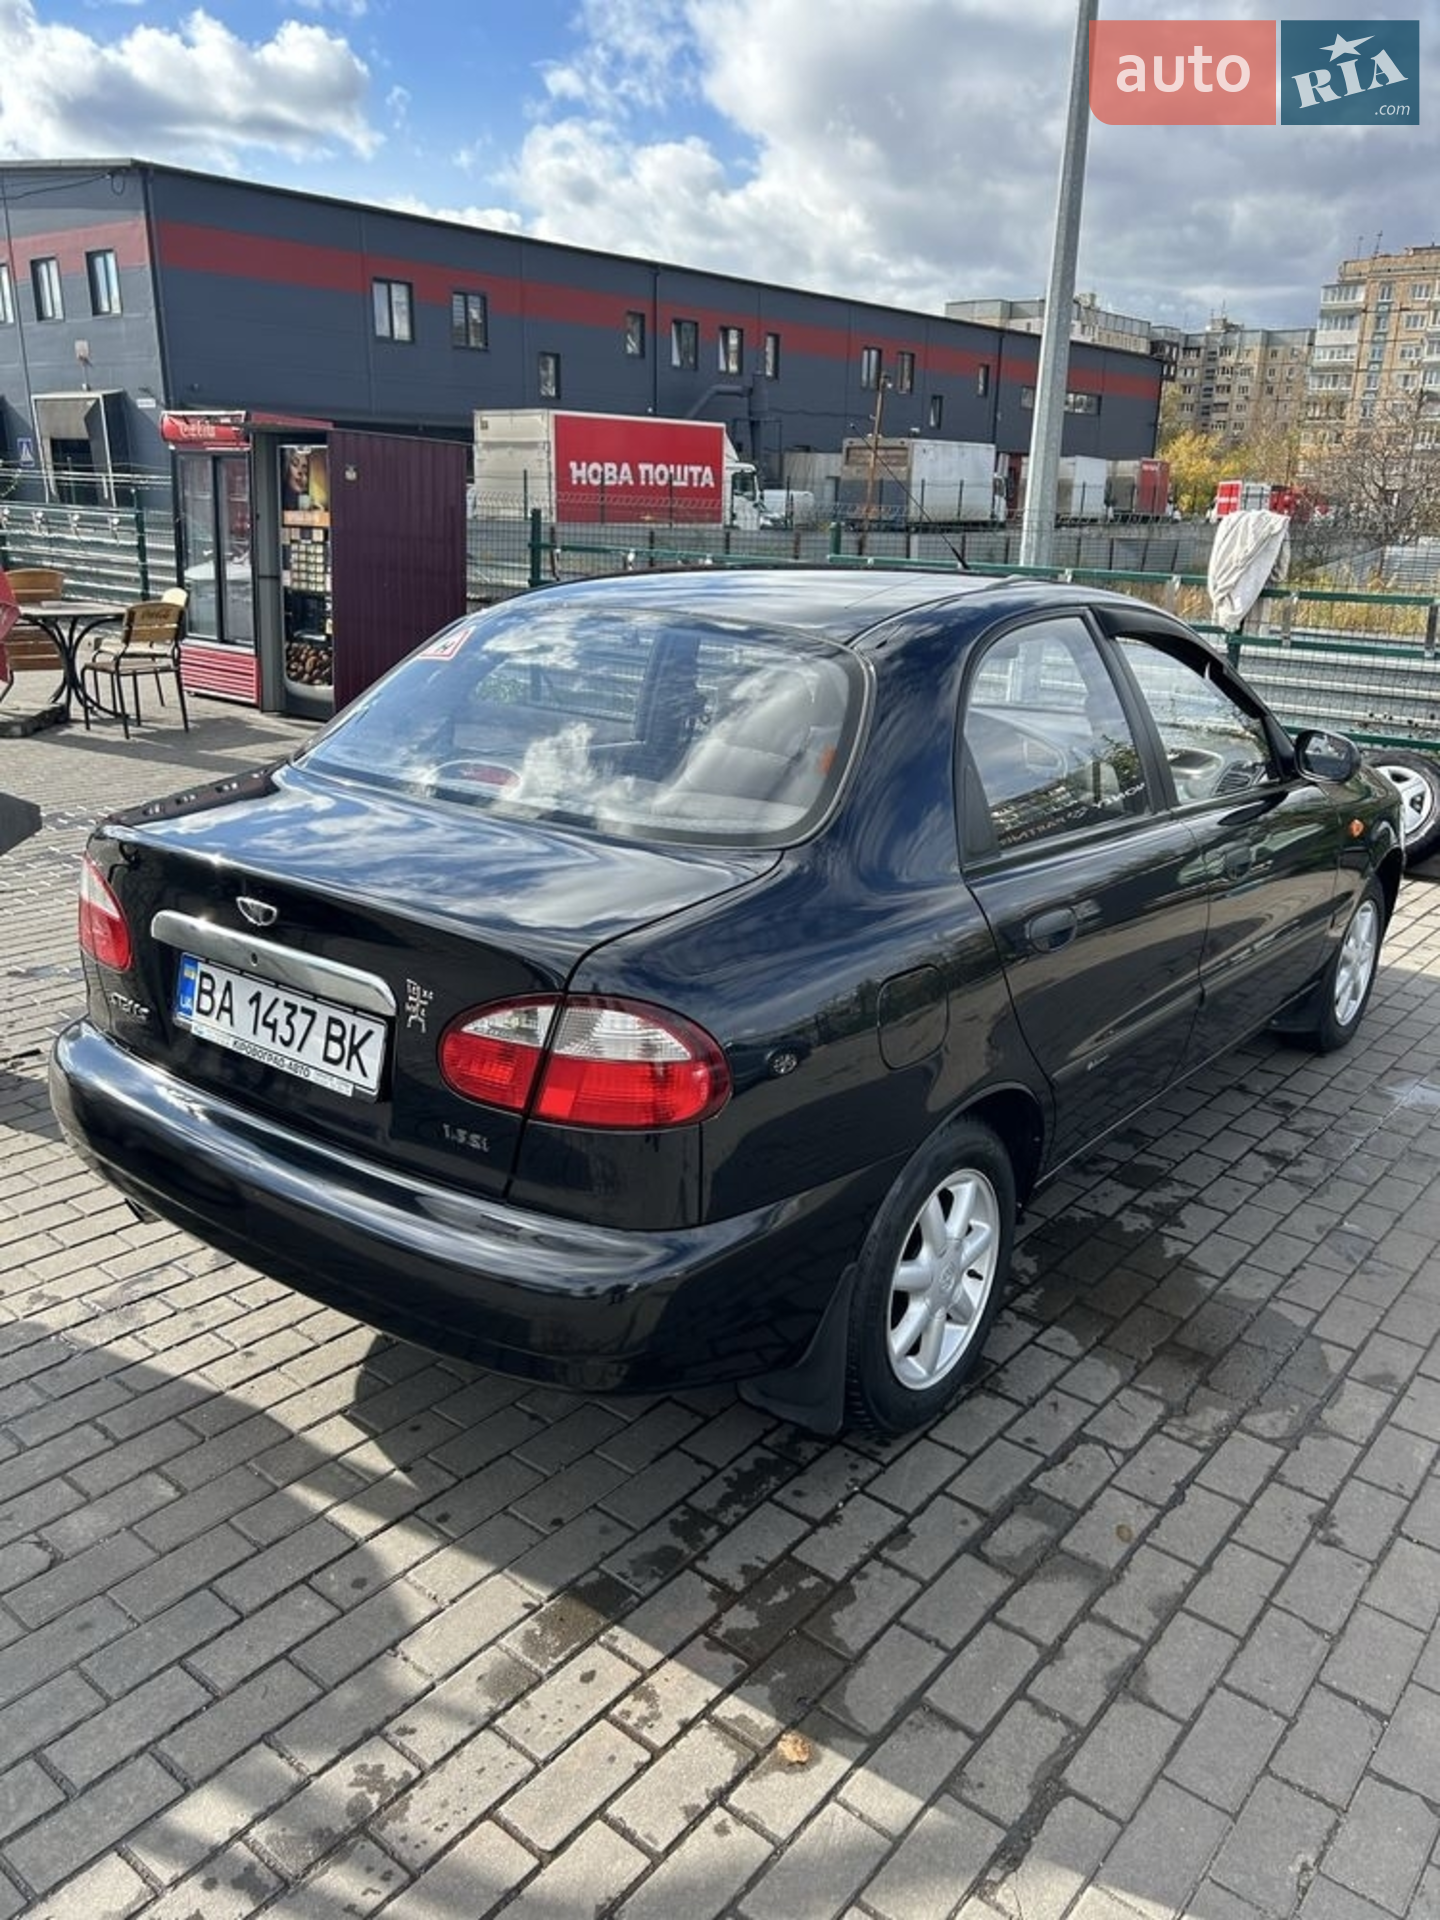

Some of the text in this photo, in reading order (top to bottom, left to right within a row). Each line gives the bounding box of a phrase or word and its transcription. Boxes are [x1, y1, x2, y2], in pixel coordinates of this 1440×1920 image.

[569, 461, 715, 488] НОВА ПОШТА
[195, 970, 235, 1028] BA
[247, 991, 318, 1053] 1437
[322, 1015, 376, 1079] BK
